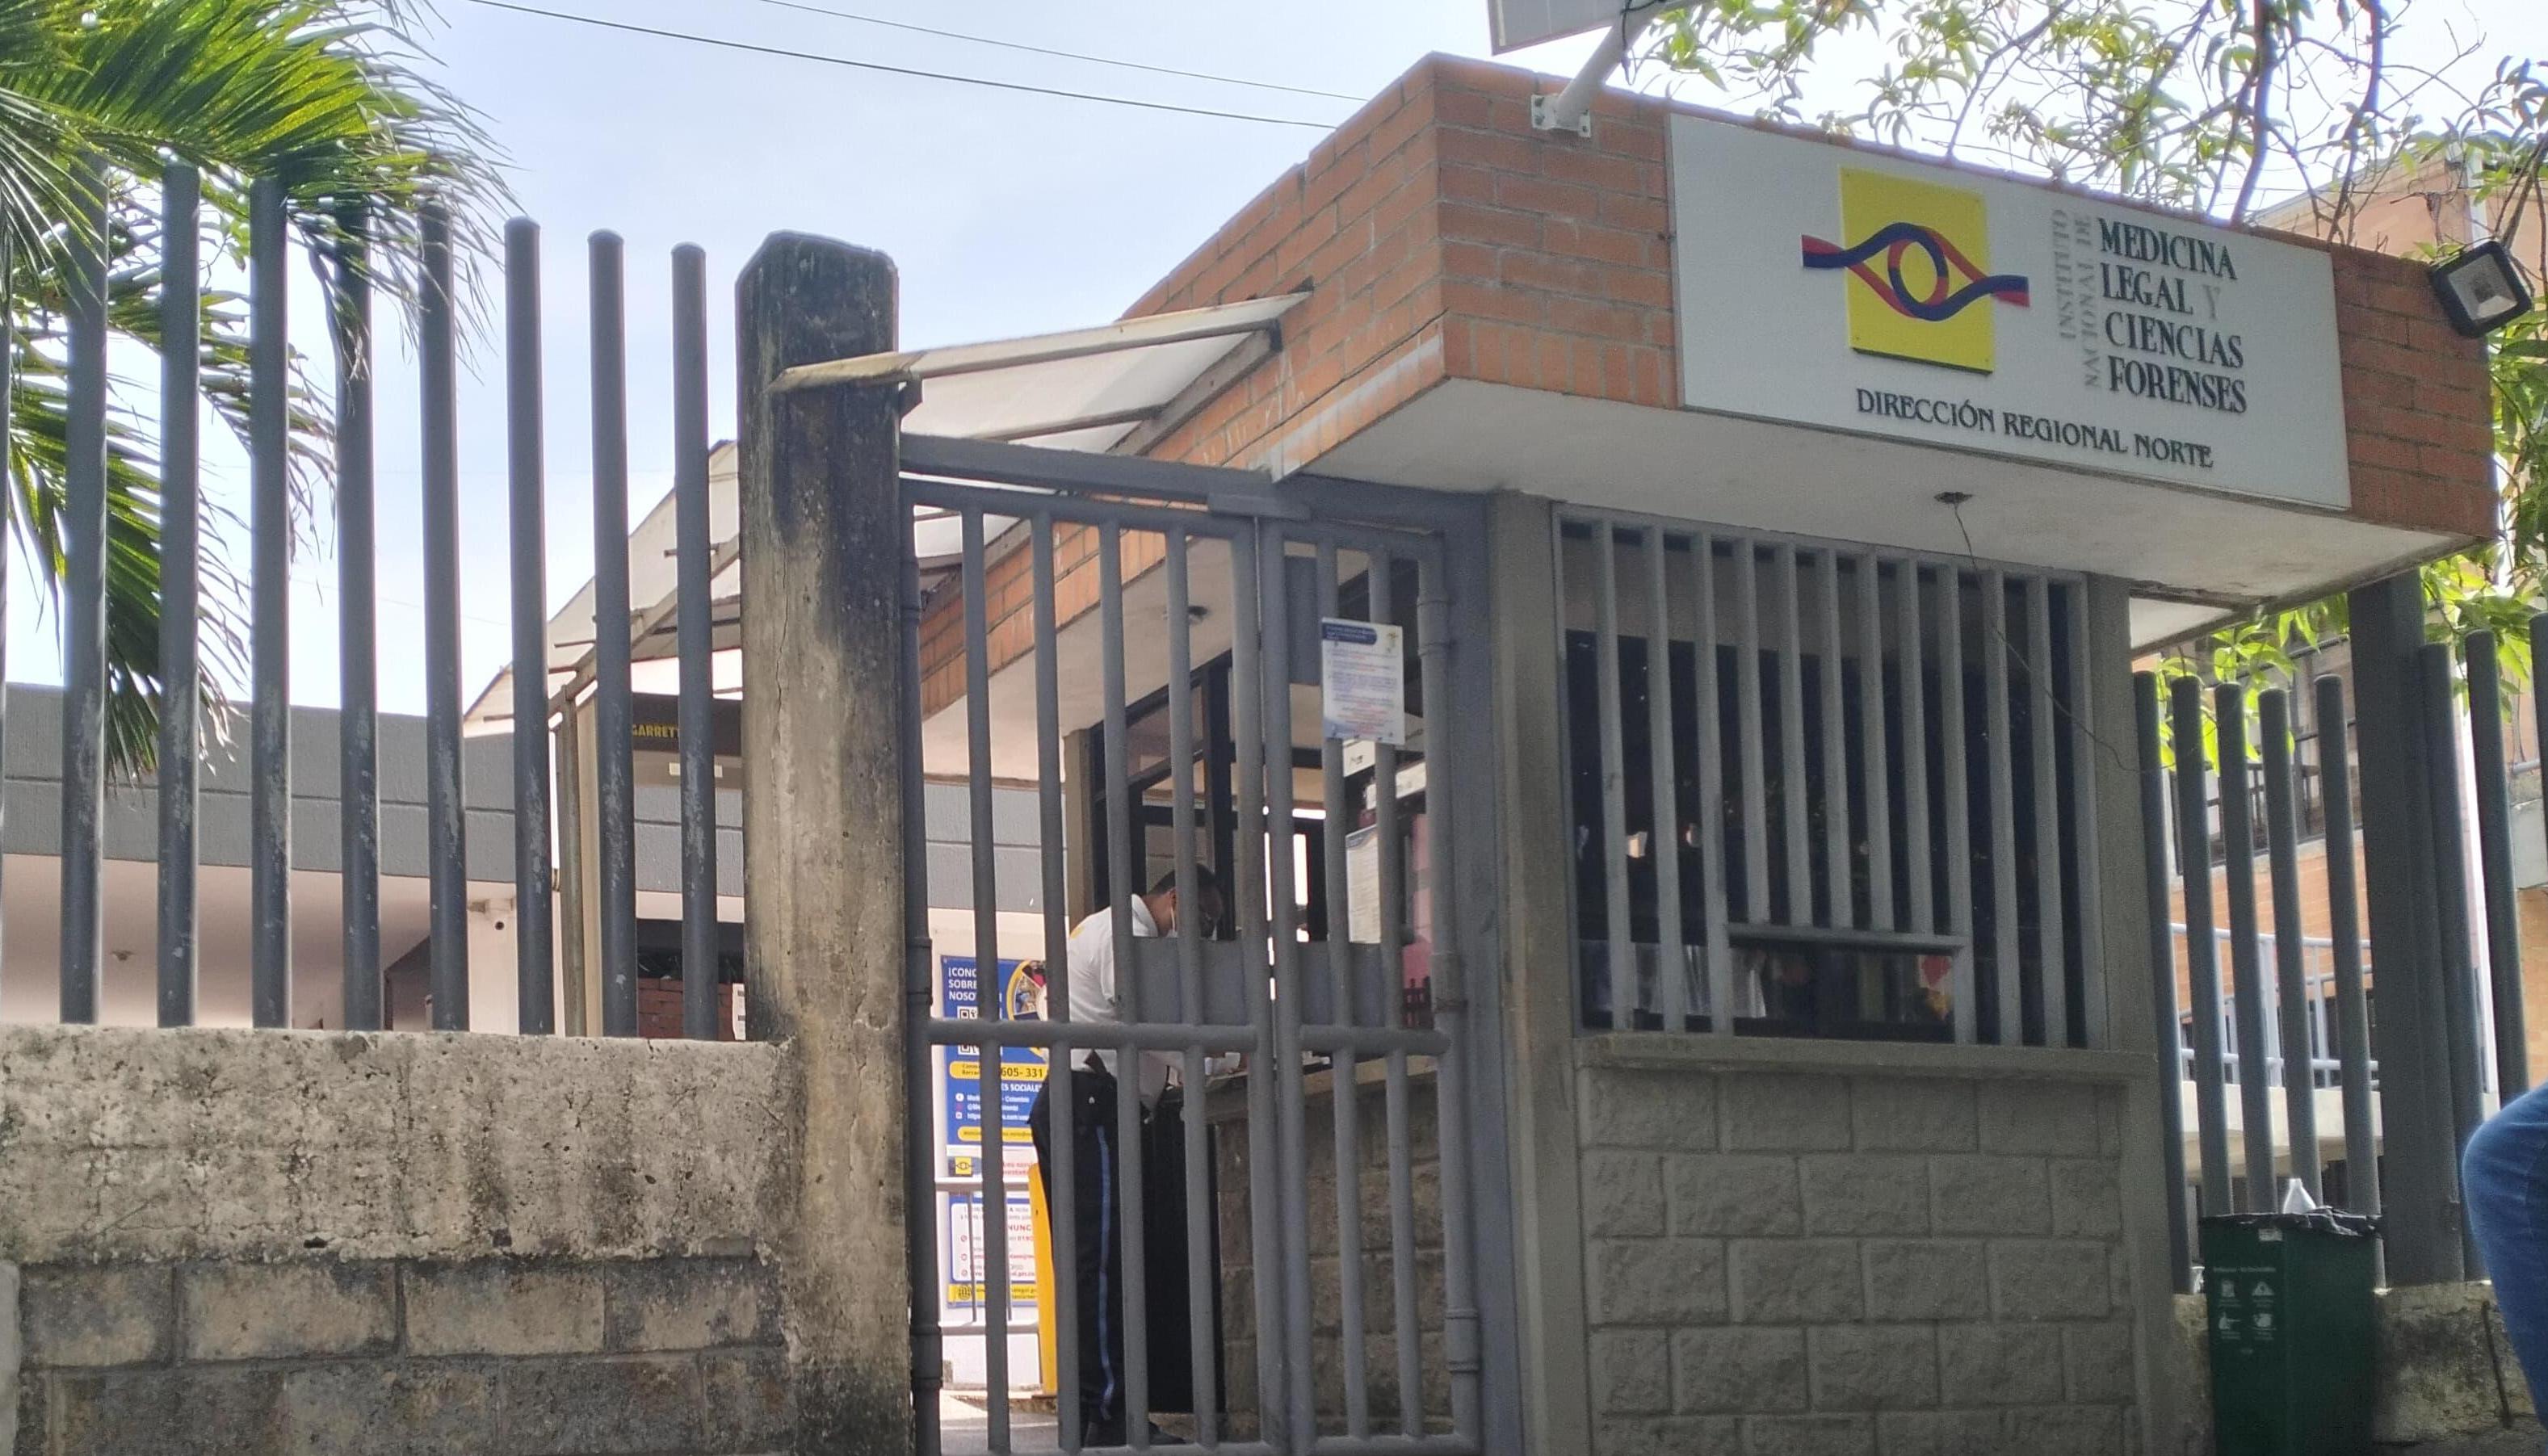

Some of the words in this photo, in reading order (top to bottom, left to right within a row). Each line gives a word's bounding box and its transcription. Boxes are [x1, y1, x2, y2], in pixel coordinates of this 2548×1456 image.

[2098, 217, 2237, 280] MEDICINA
[2100, 262, 2193, 315] LEGAL
[2202, 283, 2221, 320] Y
[2076, 259, 2101, 388] NACIONAL
[2105, 311, 2244, 368] CIENCIAS
[2108, 355, 2247, 413] FORENSES
[1856, 388, 1996, 432] DIRECCIÓN
[2002, 412, 2127, 453] REGIONAL
[2134, 433, 2214, 468] NORTE
